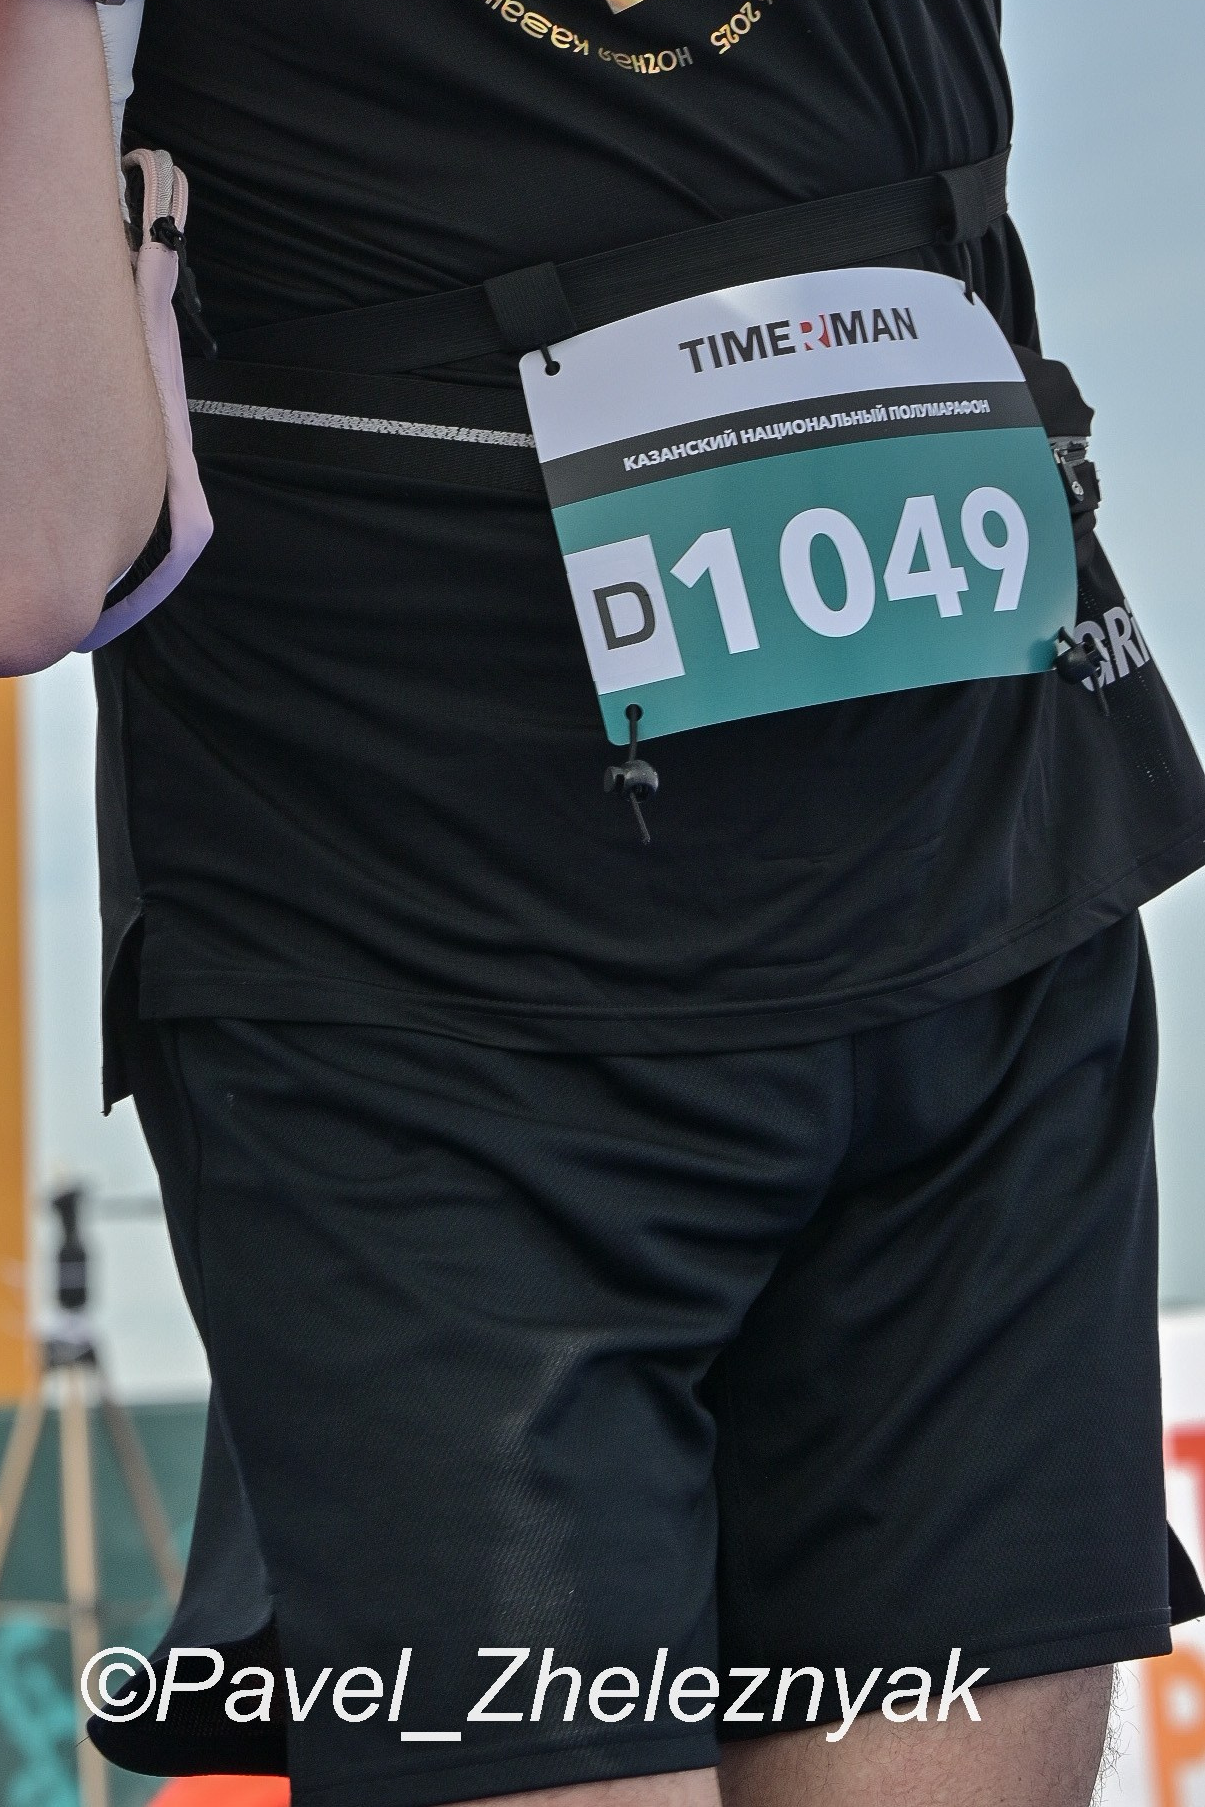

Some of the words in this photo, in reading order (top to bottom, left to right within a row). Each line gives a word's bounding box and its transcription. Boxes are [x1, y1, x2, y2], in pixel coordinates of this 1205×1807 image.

[710, 1, 762, 55] 2025
[677, 307, 919, 374] TIMERMAN
[623, 429, 738, 472] КАЗАНСКИЙ
[741, 404, 887, 444] НАЦИОНАЛЬНЫЙ
[889, 399, 991, 423] ПОЛУМАРАФОН
[593, 581, 657, 650] D
[670, 486, 1030, 655] 1049
